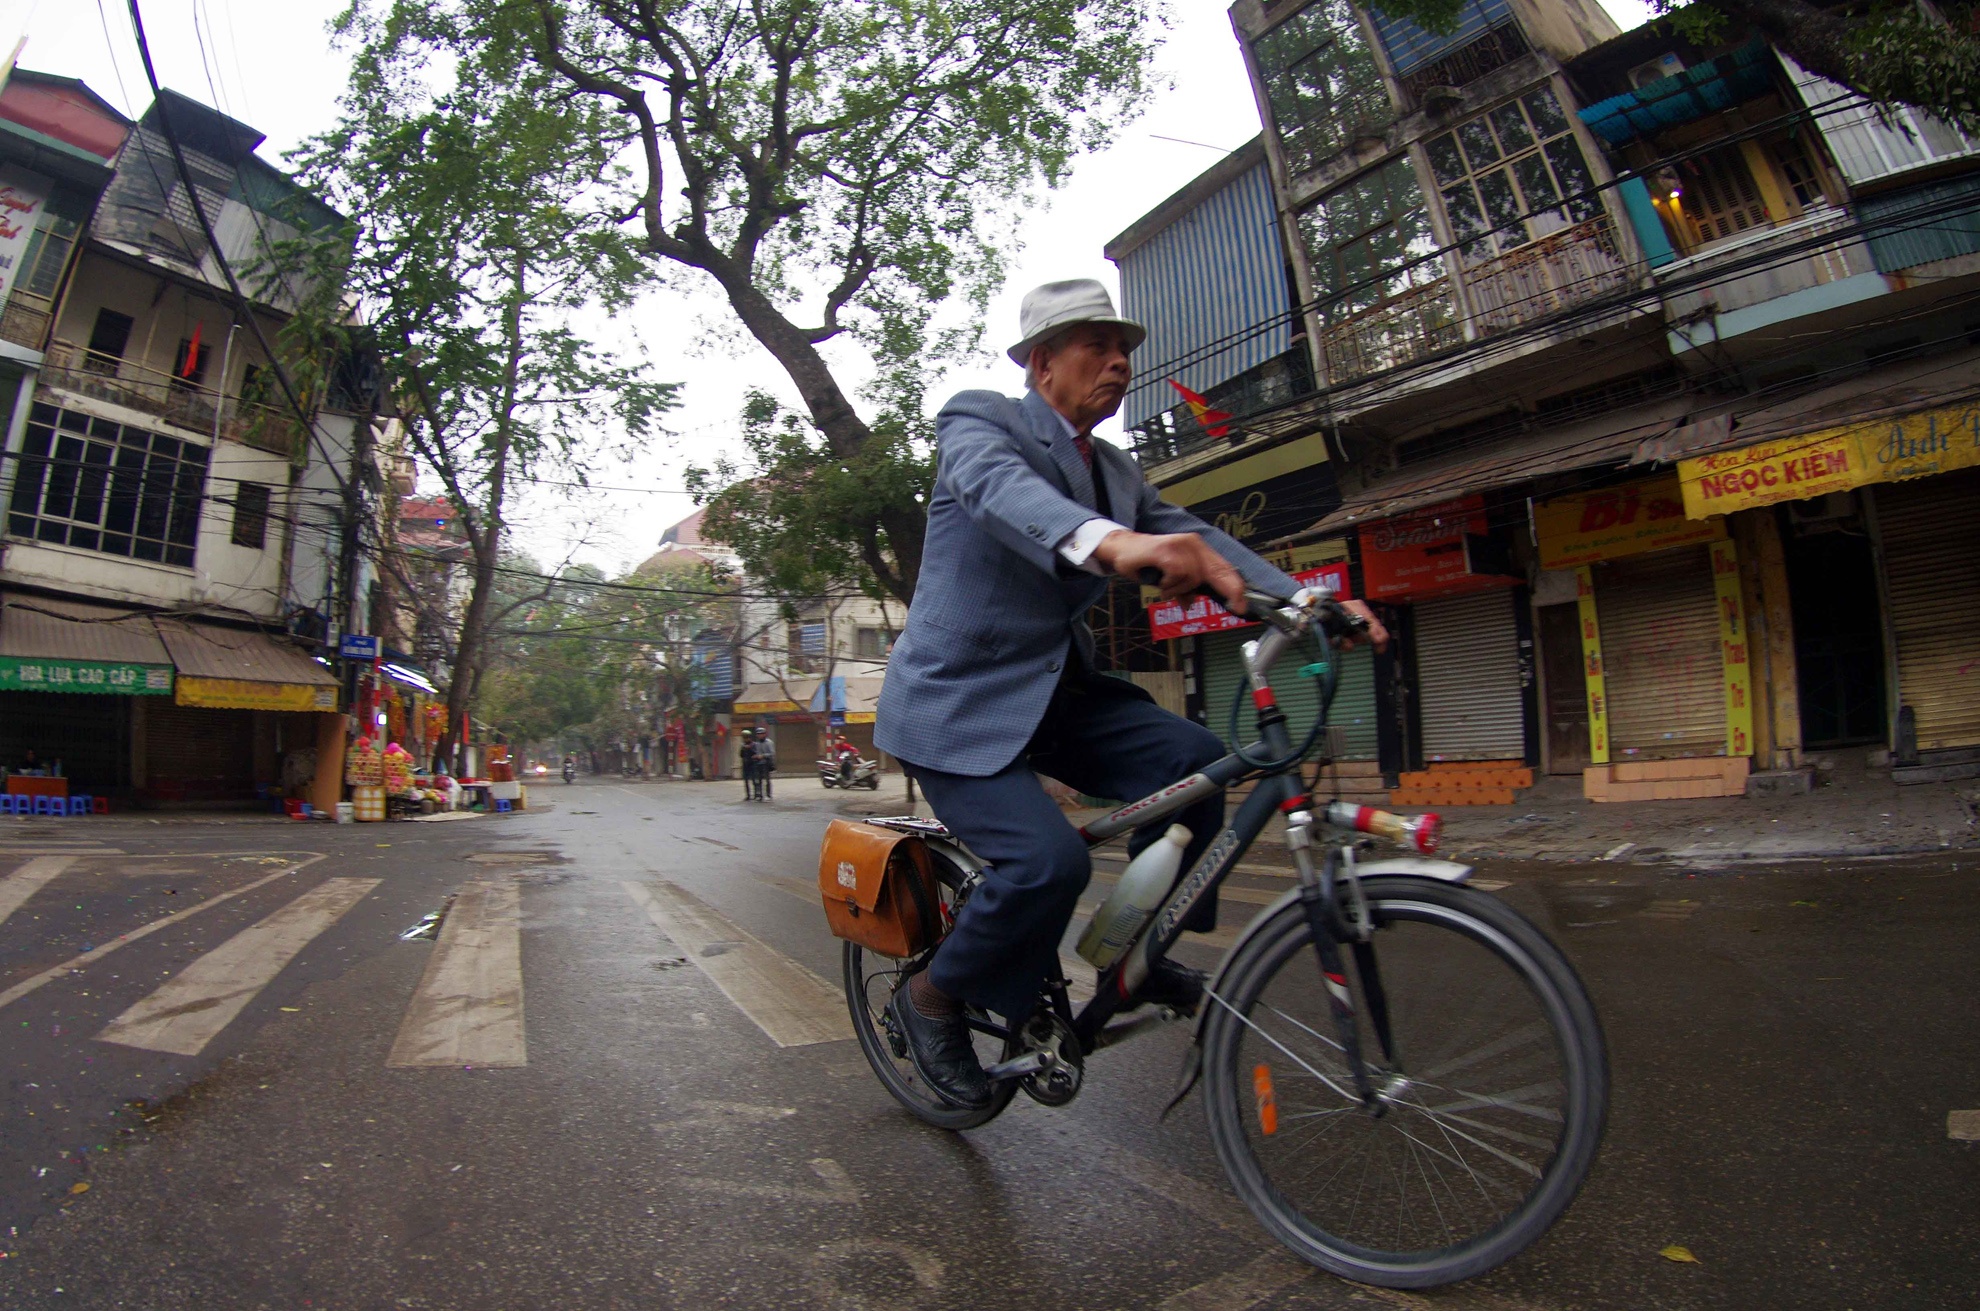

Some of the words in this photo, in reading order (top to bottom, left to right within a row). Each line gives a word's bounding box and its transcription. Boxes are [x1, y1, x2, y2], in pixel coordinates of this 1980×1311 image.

[1700, 465, 1779, 499] NGỌC
[1110, 794, 1160, 822] FORCE
[1164, 777, 1198, 797] ONE
